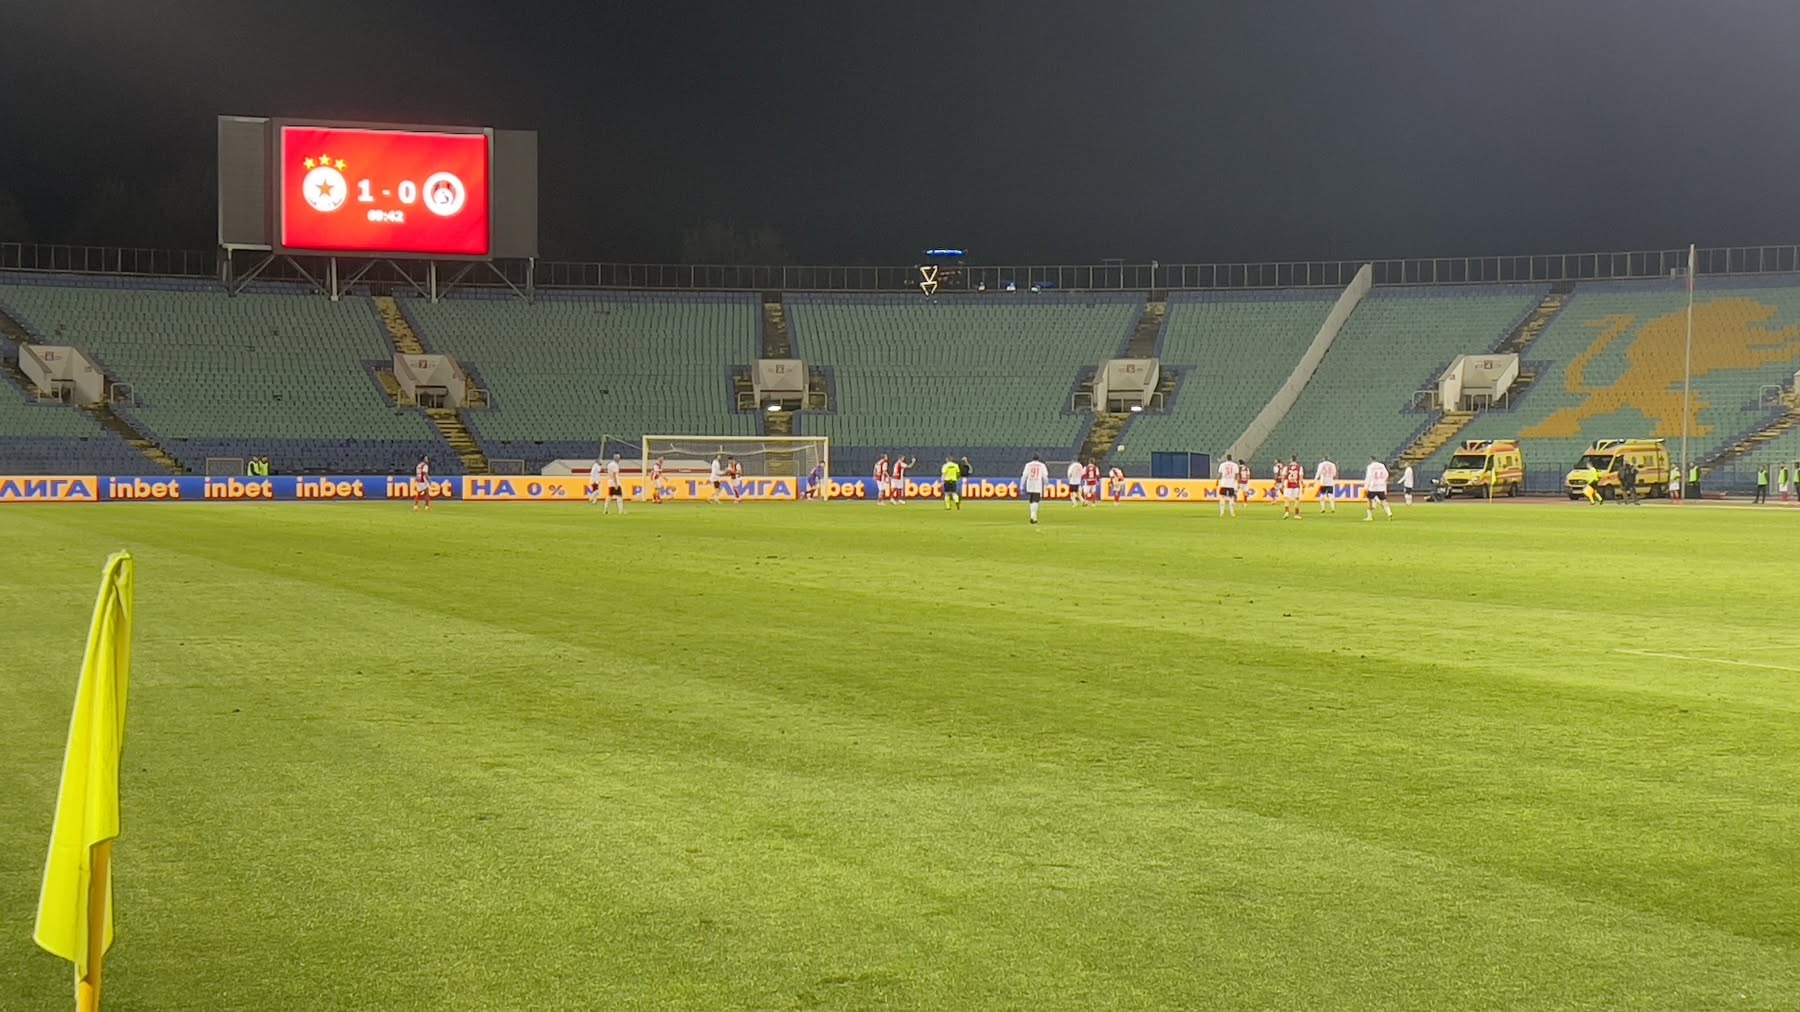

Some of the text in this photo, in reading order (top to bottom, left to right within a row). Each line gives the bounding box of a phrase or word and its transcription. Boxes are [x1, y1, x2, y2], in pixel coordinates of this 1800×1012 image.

[358, 179, 374, 202] 1
[398, 180, 417, 204] 0
[0, 480, 91, 497] ЛИГА
[109, 477, 180, 498] inbet
[204, 477, 272, 498] inbet
[296, 476, 363, 498] inbet
[471, 480, 515, 496] НА
[962, 478, 1018, 498] inbet
